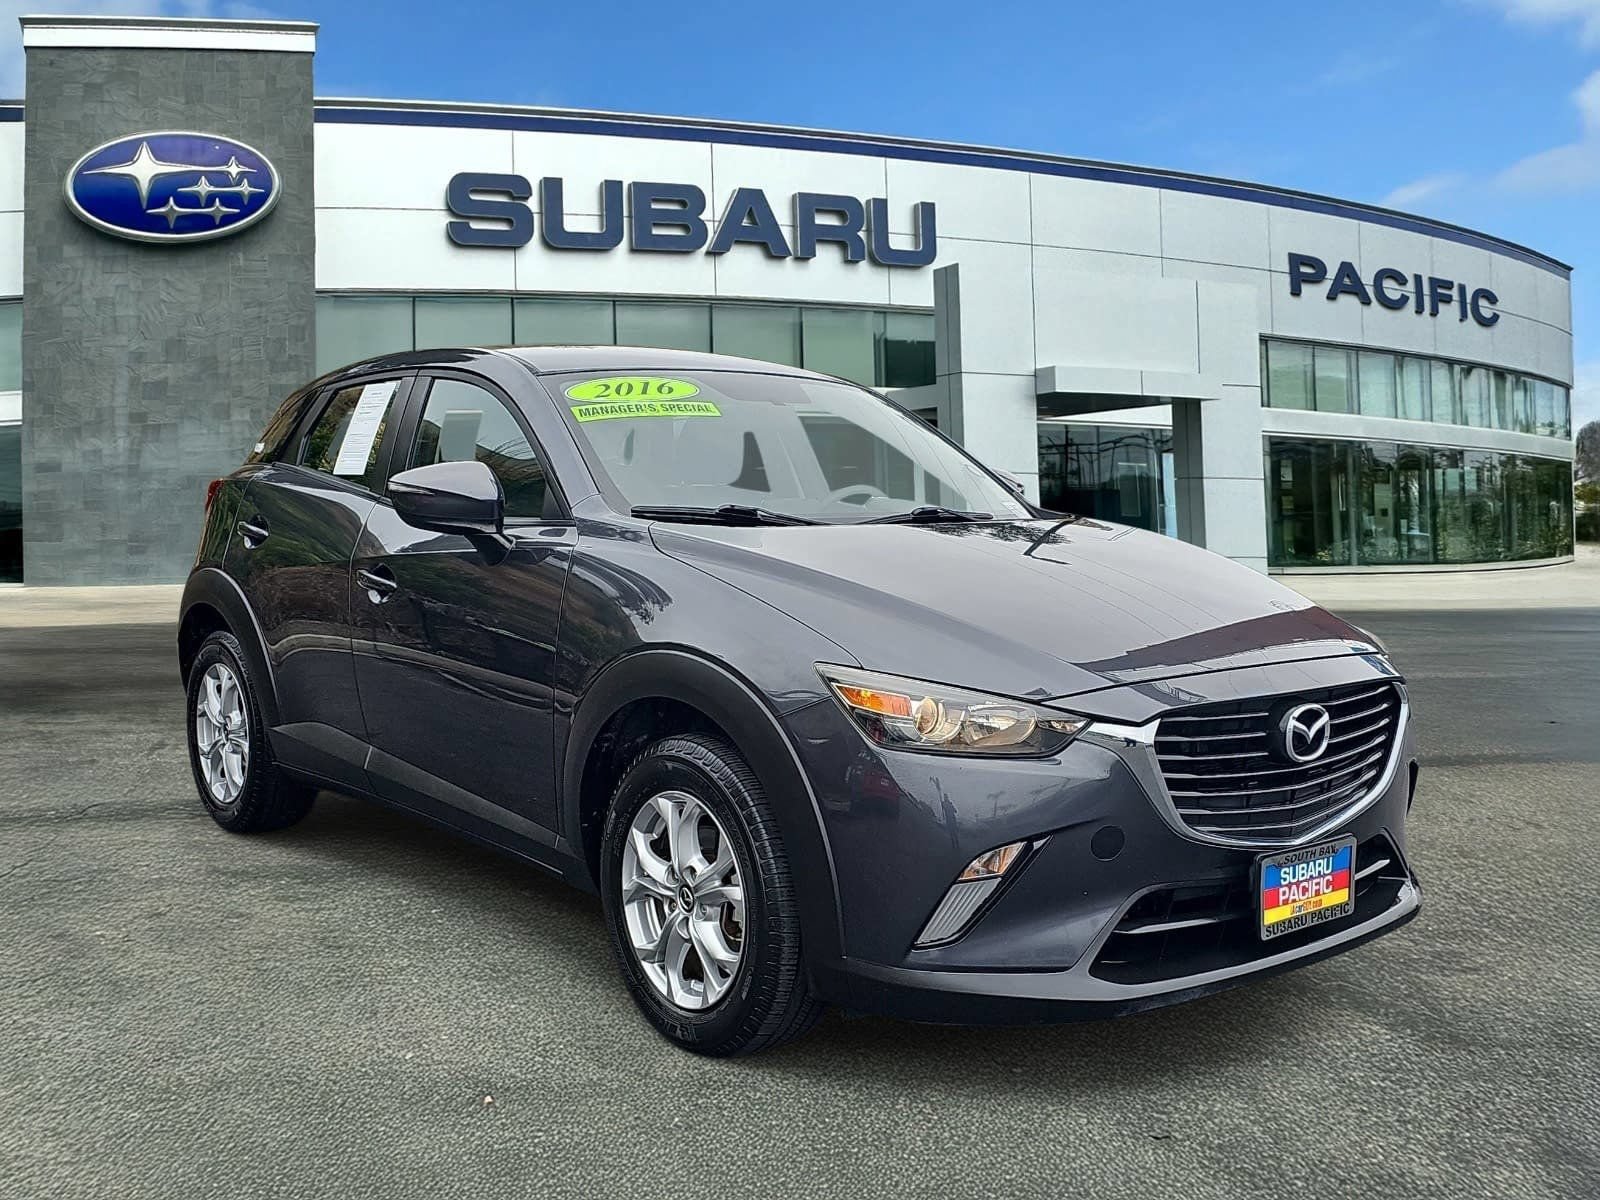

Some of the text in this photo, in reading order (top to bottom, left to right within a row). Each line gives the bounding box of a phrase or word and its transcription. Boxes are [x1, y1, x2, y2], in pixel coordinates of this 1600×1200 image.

[446, 172, 937, 267] SUBARU
[1288, 252, 1500, 327] PACIFIC
[594, 380, 674, 399] 2016
[578, 402, 713, 418] MANAGER'S SPECIAL
[1280, 857, 1333, 885] SUBARU
[1284, 849, 1316, 864] SOUTH
[1279, 875, 1333, 906] PACIFIC
[1265, 902, 1350, 938] SUBARU PACIFIC
